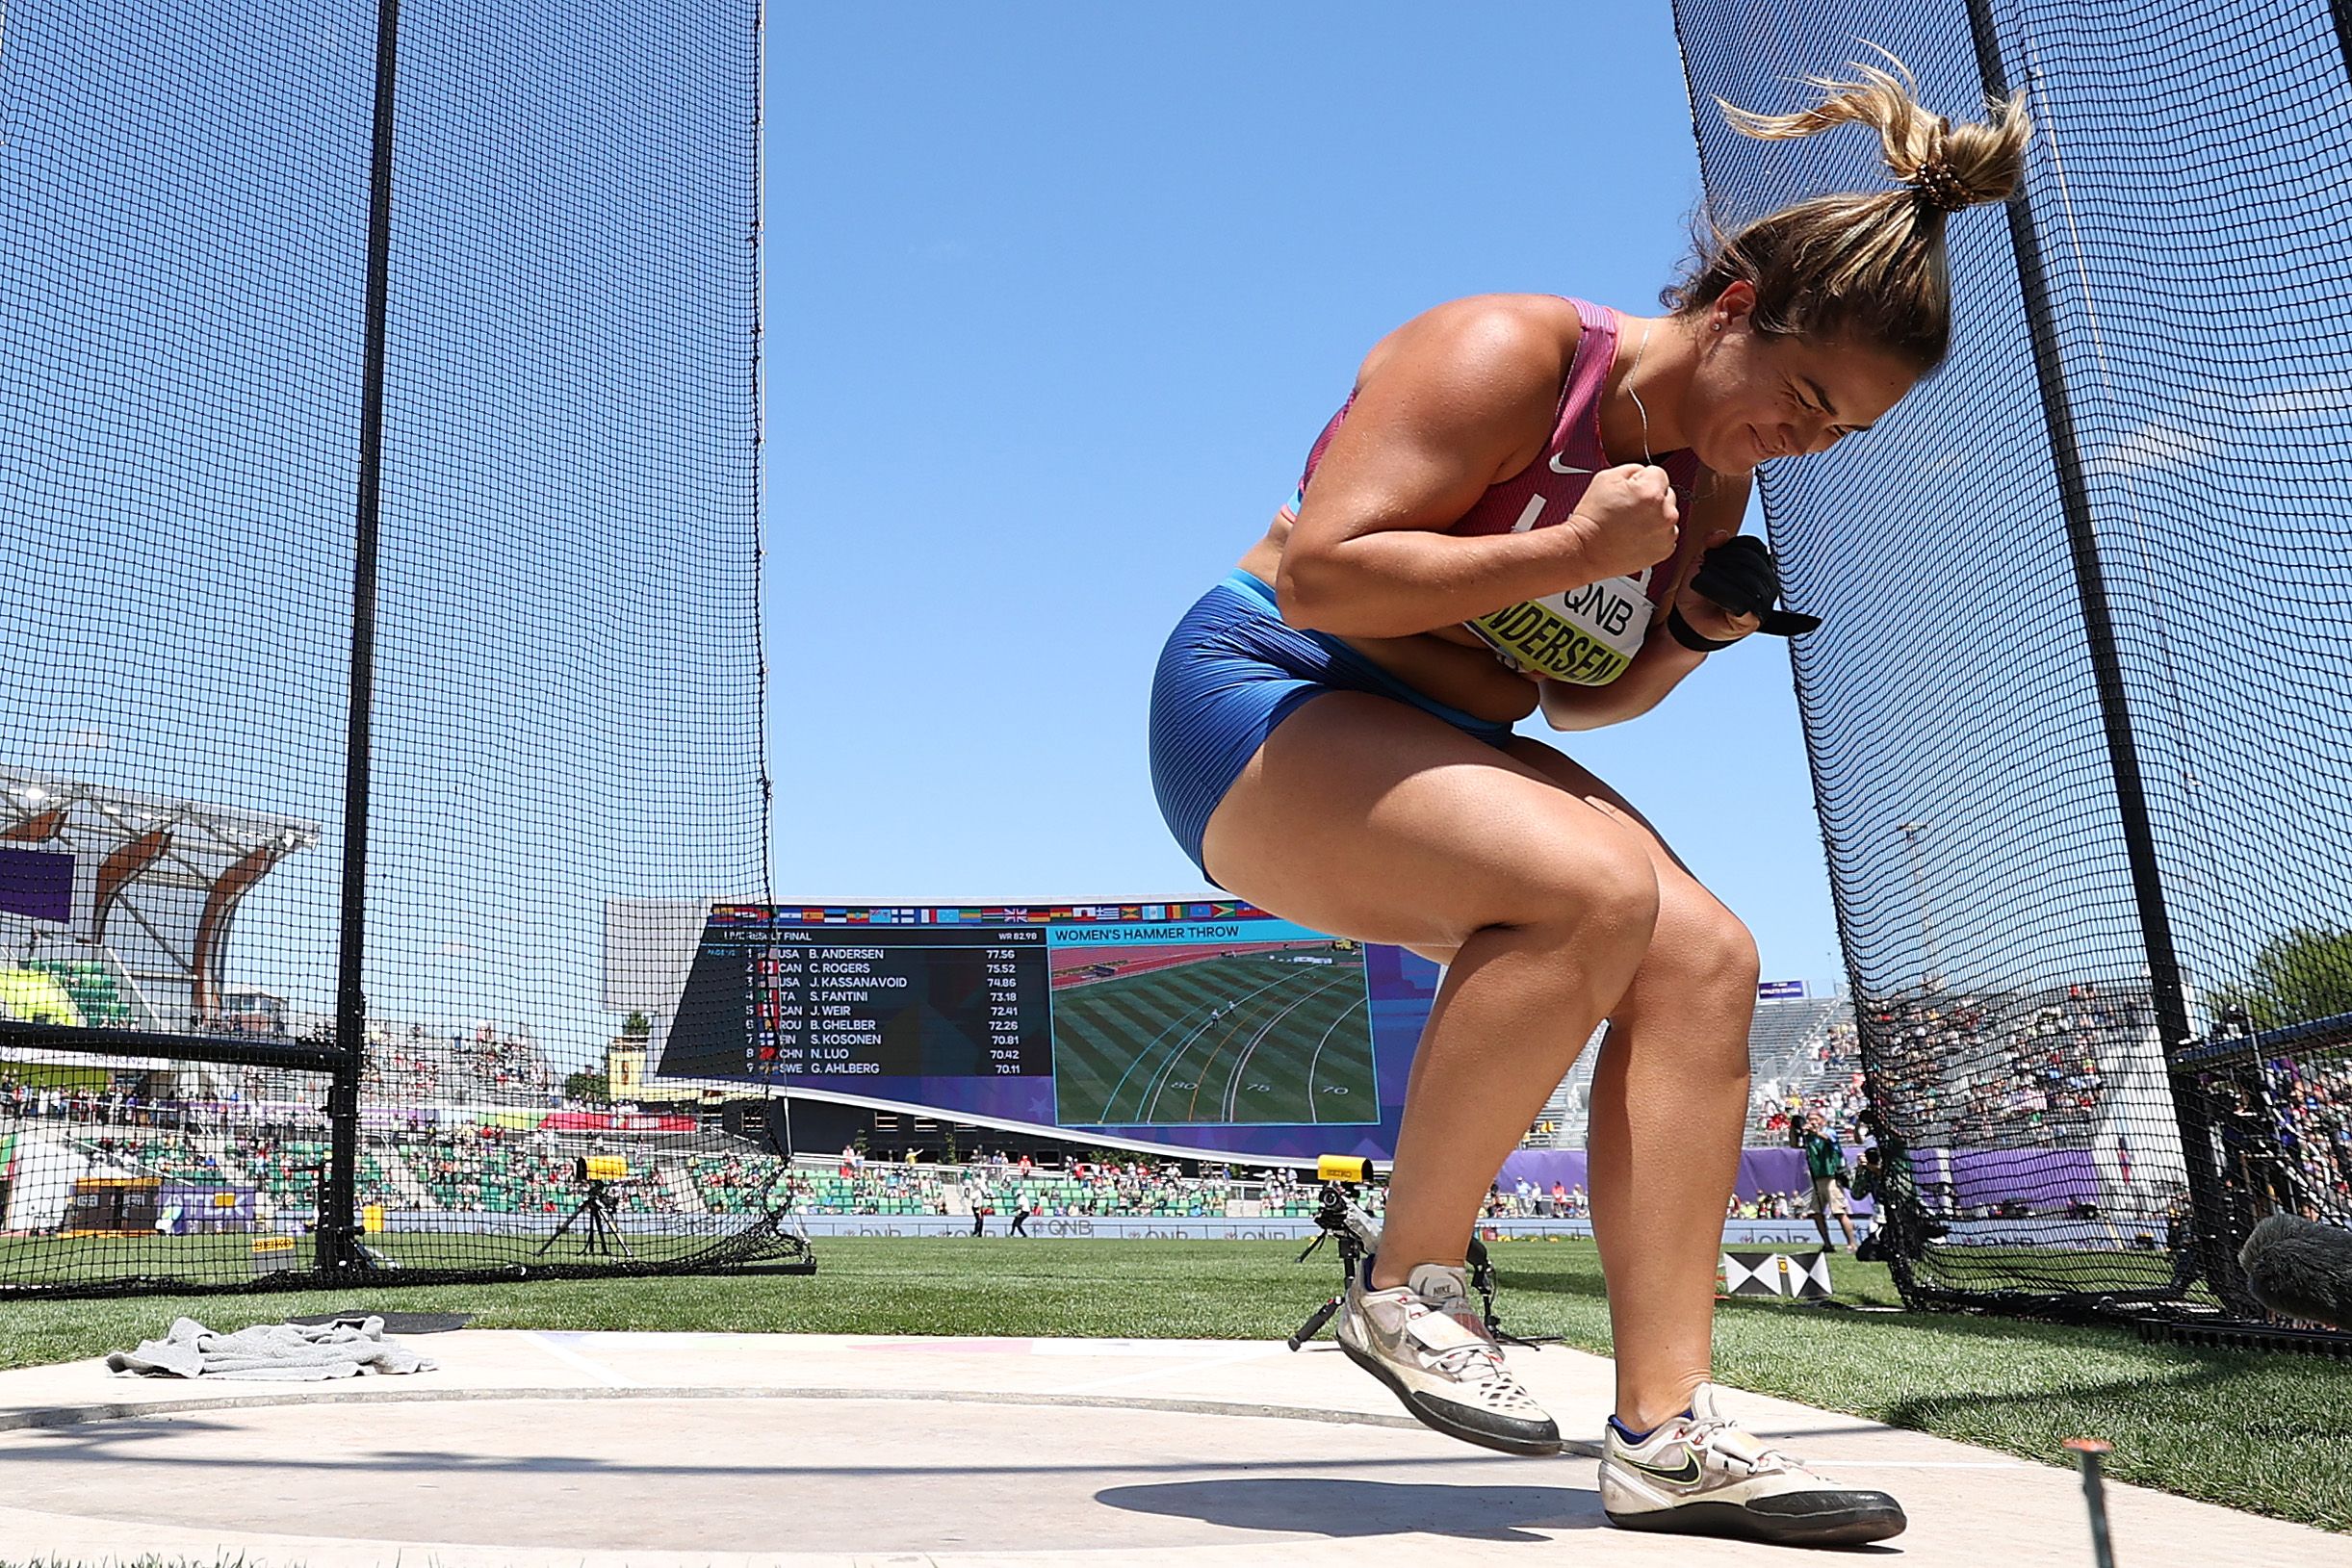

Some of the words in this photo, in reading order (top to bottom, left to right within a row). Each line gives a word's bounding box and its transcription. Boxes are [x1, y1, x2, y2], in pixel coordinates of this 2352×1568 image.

[1564, 583, 1634, 636] QNB
[1479, 601, 1622, 683] NDERSEN
[784, 932, 813, 941] FINAL
[1055, 929, 1121, 941] WOMEN'S
[1124, 928, 1185, 940] HAMMER
[1187, 926, 1239, 938] THROW
[778, 949, 800, 959] USA
[809, 949, 819, 959] B.
[821, 949, 884, 959] ANDERSEN
[986, 950, 1015, 959] 77.56
[745, 963, 754, 972] 2
[779, 964, 802, 973] CAN
[810, 964, 820, 973] C.
[822, 964, 870, 973] ROGERS
[987, 964, 1016, 973] 75.52
[779, 978, 800, 988] USA
[810, 978, 819, 988] J.
[821, 978, 908, 988] KASSANAVOID
[987, 978, 1017, 988] 74.86
[780, 991, 796, 1001] TA
[810, 991, 819, 1001] S.
[821, 991, 868, 1001] FANTINI
[990, 992, 1017, 1002] 73.18
[746, 1005, 754, 1015] 5
[779, 1006, 802, 1015] CAN
[810, 1006, 820, 1015] J.
[821, 1006, 851, 1015] WEIR
[991, 1007, 1018, 1015] 72.41
[746, 1019, 754, 1030] 6
[779, 1020, 802, 1030] ROU
[810, 1020, 820, 1030] B.
[822, 1020, 876, 1030] GHELBER
[988, 1021, 1018, 1030] 72.26
[746, 1034, 754, 1044] 7
[810, 1035, 821, 1044] S.
[822, 1035, 881, 1044] KOSONEN
[992, 1036, 1019, 1044] 70.81
[746, 1048, 754, 1059] 8
[779, 1049, 802, 1059] CHN
[811, 1049, 822, 1059] N.
[824, 1049, 849, 1059] LUO
[990, 1050, 1020, 1060] 70.42
[779, 1064, 803, 1073] SWE
[811, 1064, 822, 1073] G.
[824, 1064, 880, 1073] AHLBERG
[995, 1065, 1021, 1074] 70.11
[1171, 1081, 1197, 1091] 80
[1321, 1085, 1349, 1095] 70
[1047, 1220, 1091, 1236] QNB
